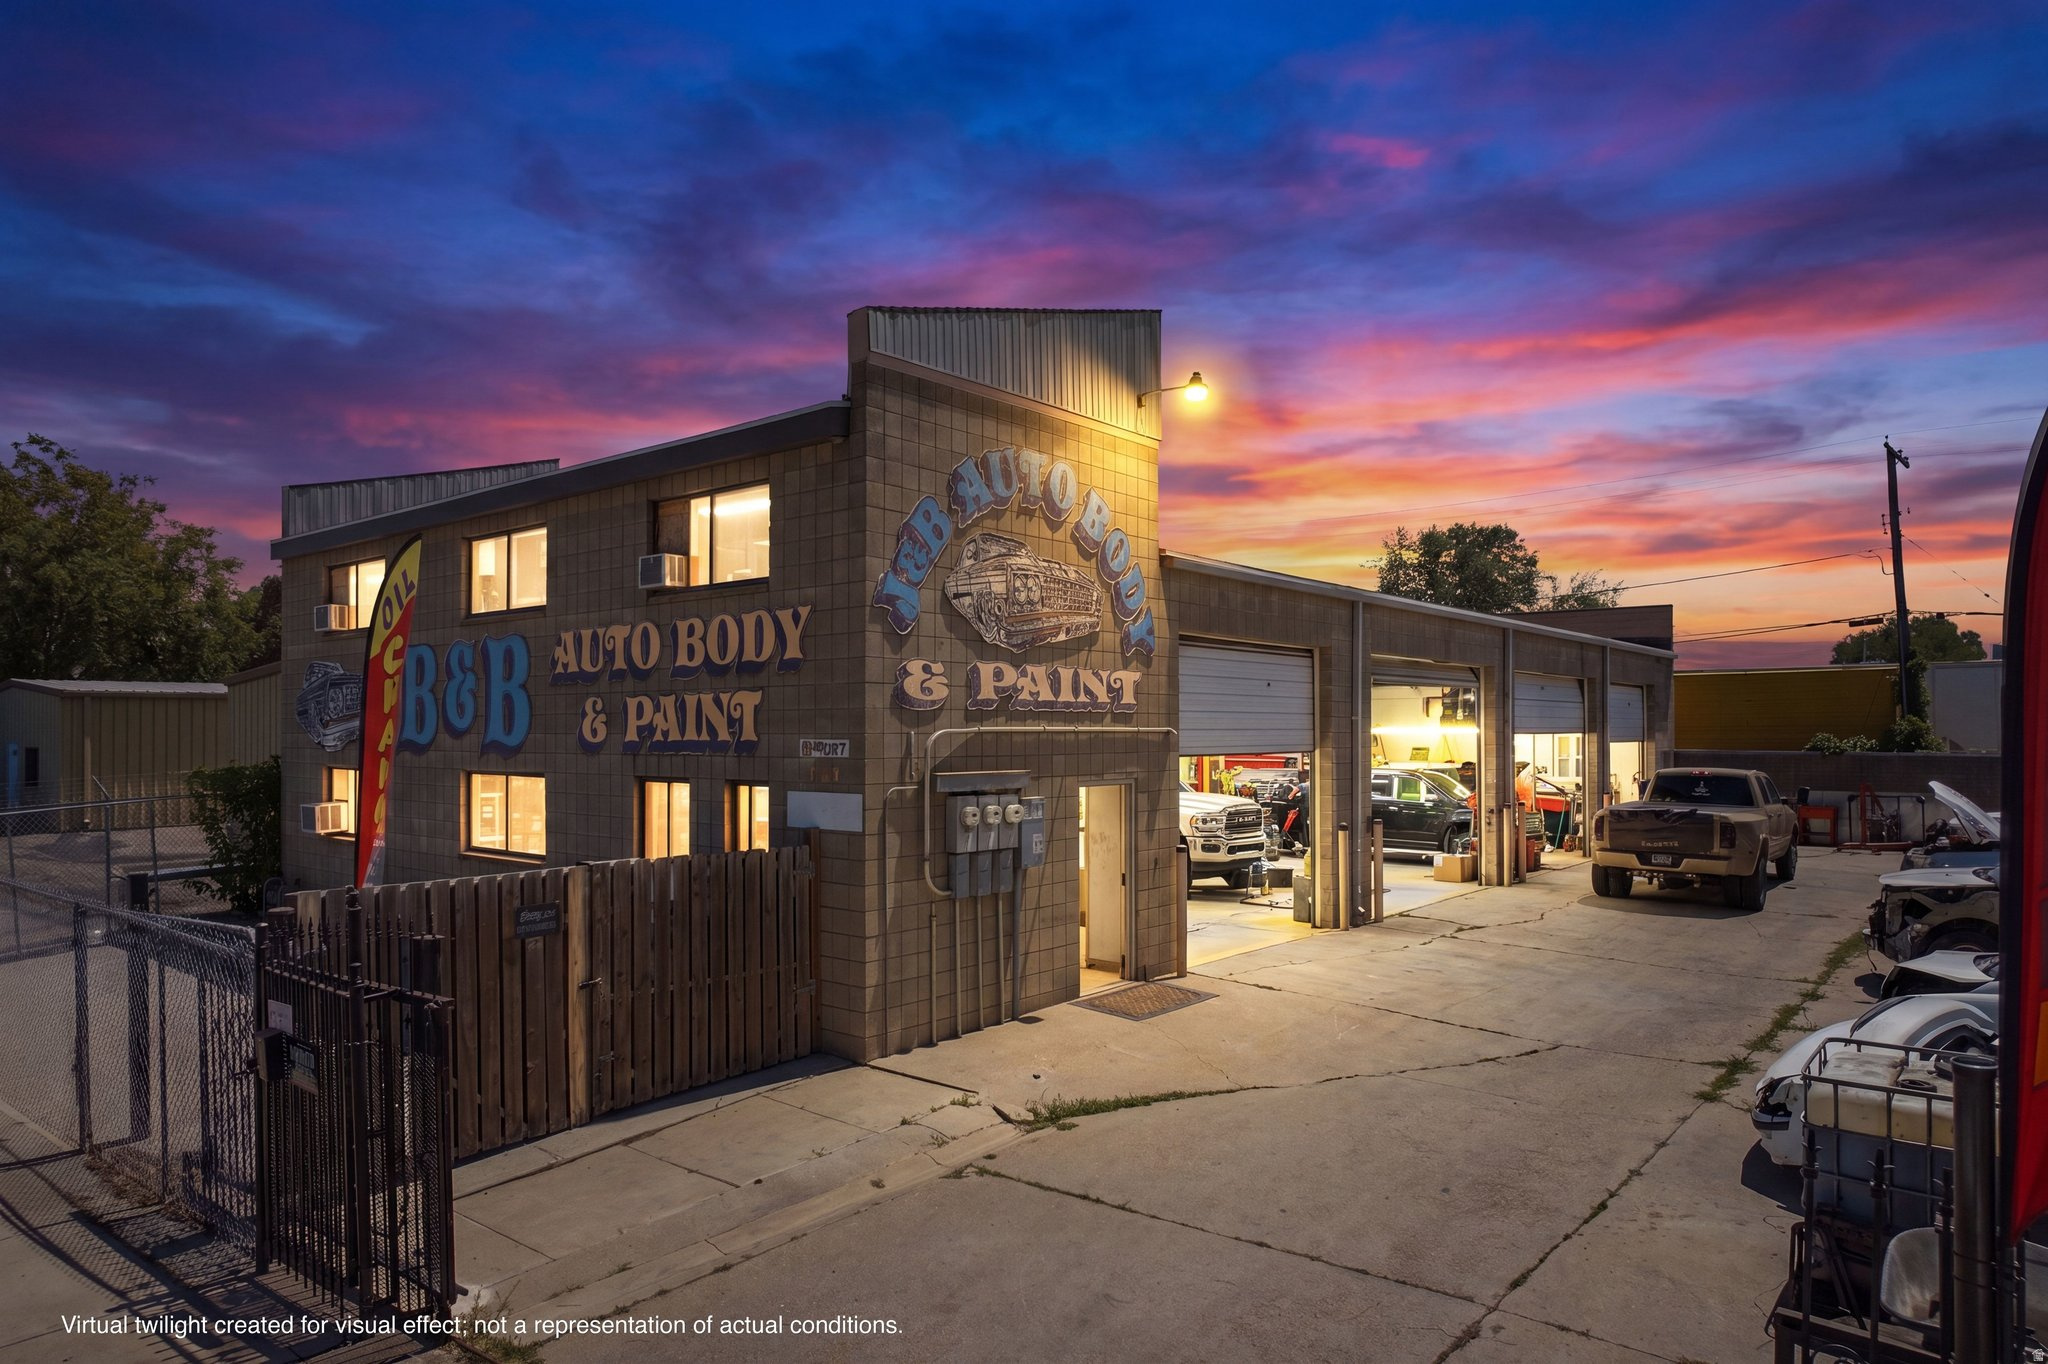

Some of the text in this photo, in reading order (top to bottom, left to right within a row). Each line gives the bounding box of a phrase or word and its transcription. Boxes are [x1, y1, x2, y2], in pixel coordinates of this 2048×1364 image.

[950, 446, 1077, 528] AUTO
[1072, 486, 1156, 656] BODY
[382, 568, 416, 630] OIL
[550, 604, 813, 685] AUTO BODY
[396, 632, 532, 758] B&B
[896, 657, 1142, 712] & PAINT
[577, 689, 764, 756] & PAINT
